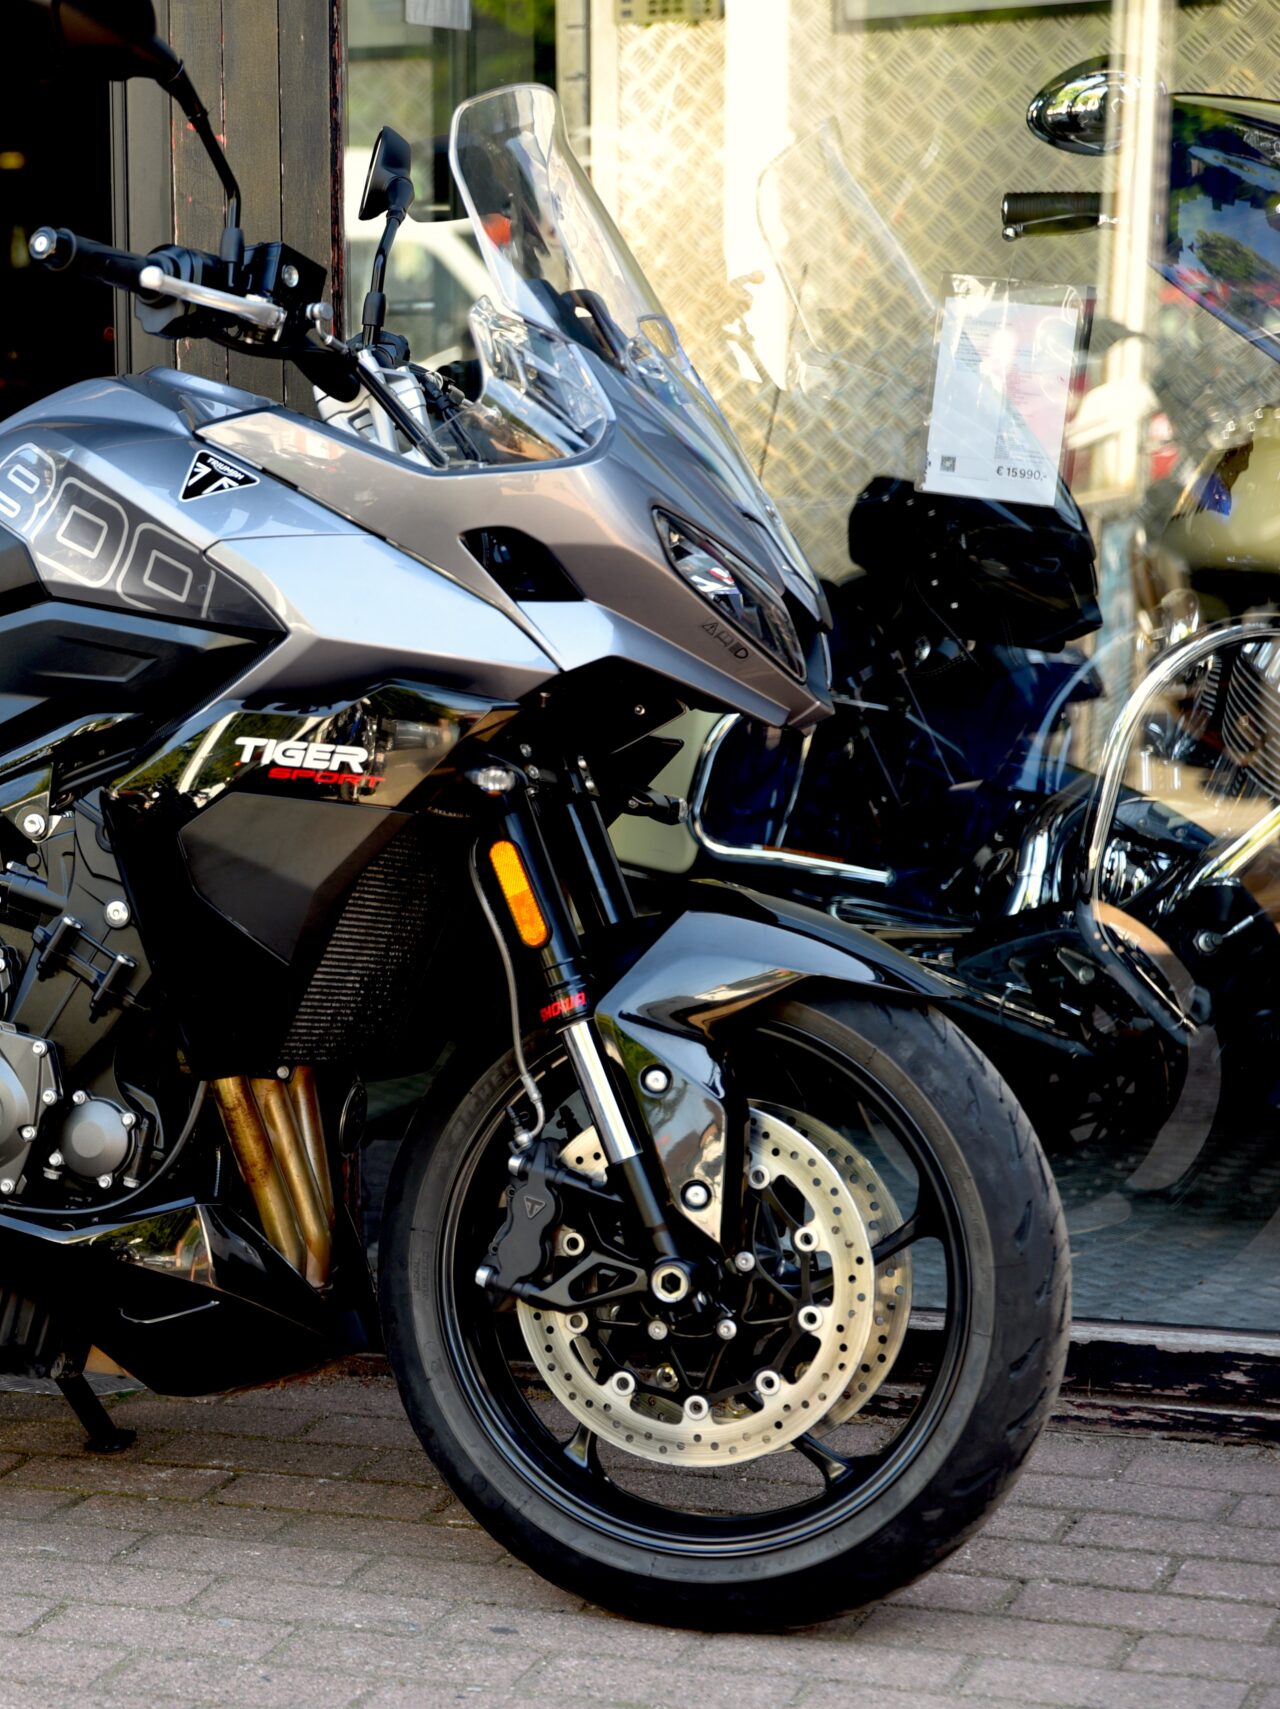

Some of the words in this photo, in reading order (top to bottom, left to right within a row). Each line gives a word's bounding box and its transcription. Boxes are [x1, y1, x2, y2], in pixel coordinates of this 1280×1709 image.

[207, 457, 245, 480] TRIUMPH
[234, 736, 369, 774] TIGER
[267, 767, 385, 788] SPORT
